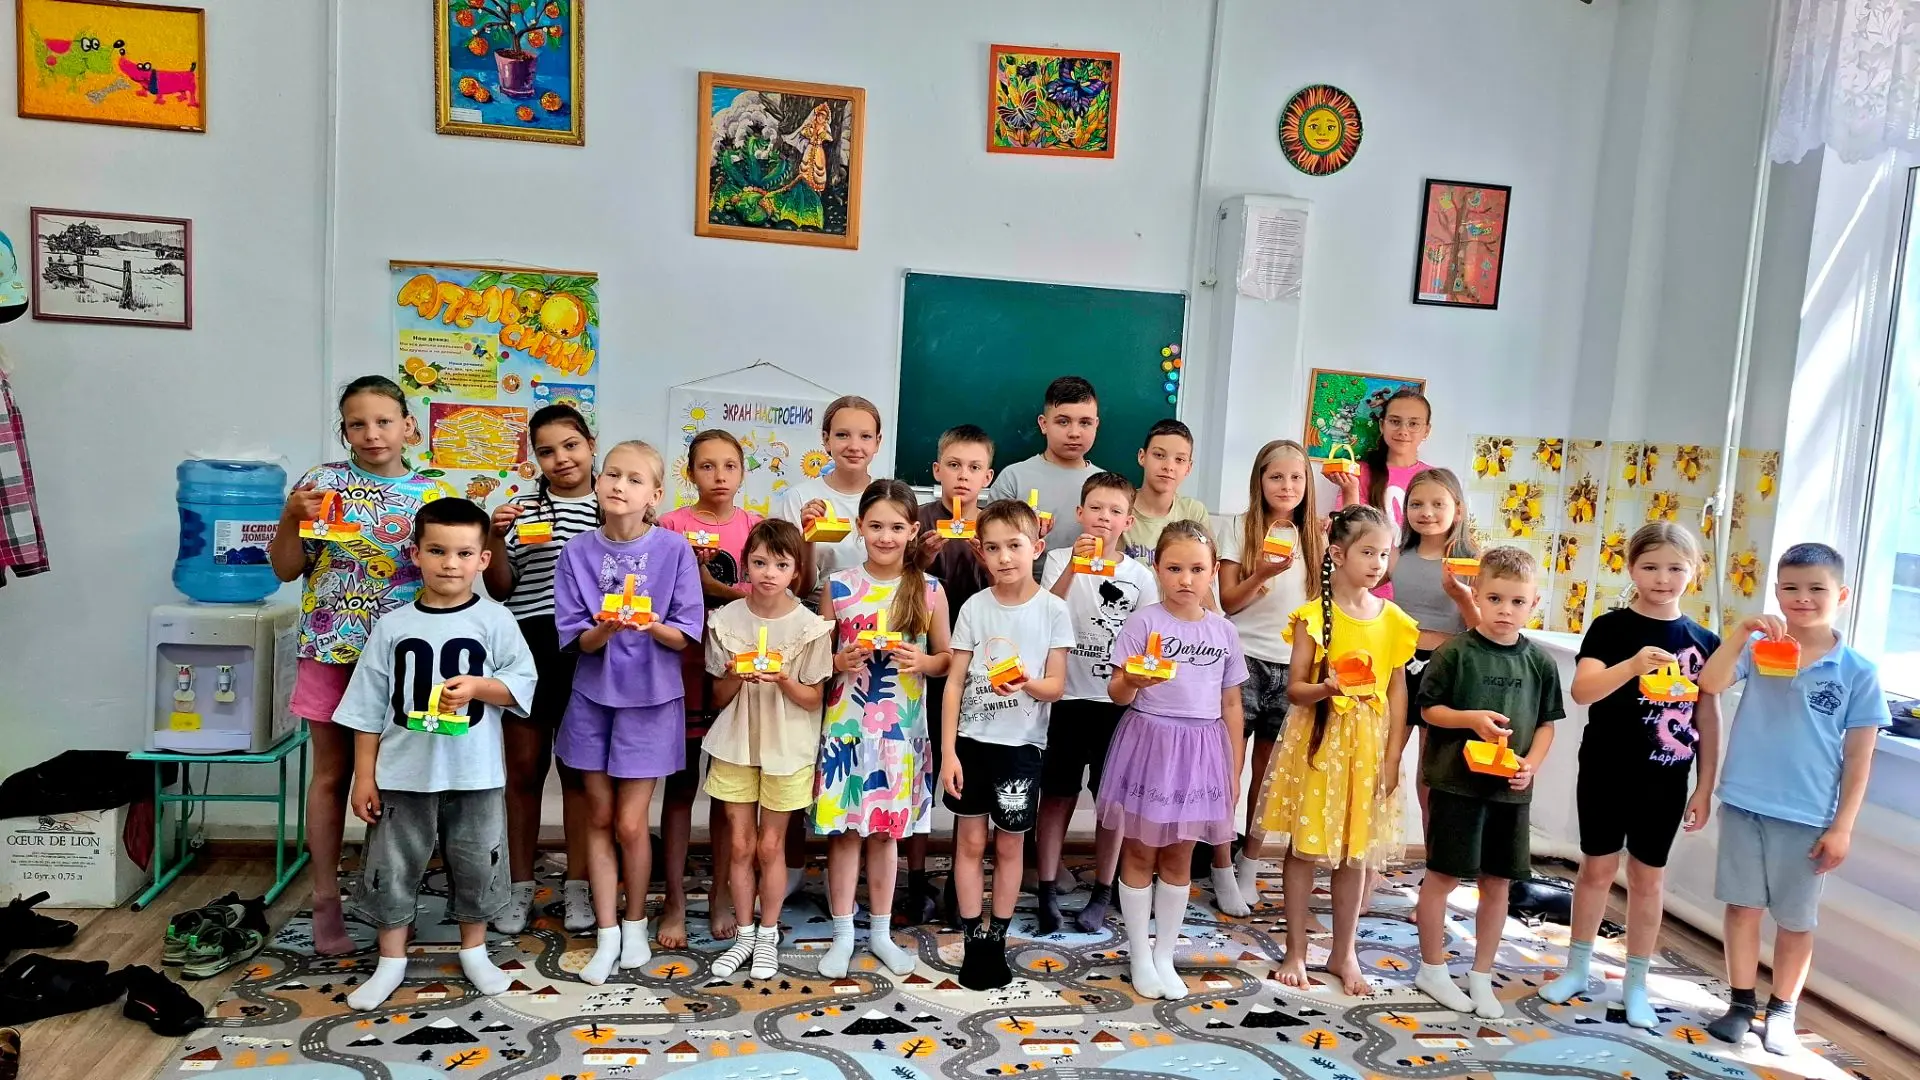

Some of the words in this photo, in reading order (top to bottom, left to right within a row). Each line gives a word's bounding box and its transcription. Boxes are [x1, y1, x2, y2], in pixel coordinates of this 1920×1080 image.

[722, 402, 752, 422] ЭКРАН
[754, 402, 813, 425] НАСТРОЕНИЯ
[1161, 637, 1229, 665] Darling
[983, 698, 1019, 711] SWIRLED
[49, 835, 66, 847] DE
[71, 836, 101, 847] LION
[23, 871, 32, 880] 12
[57, 872, 76, 881] 0,75
